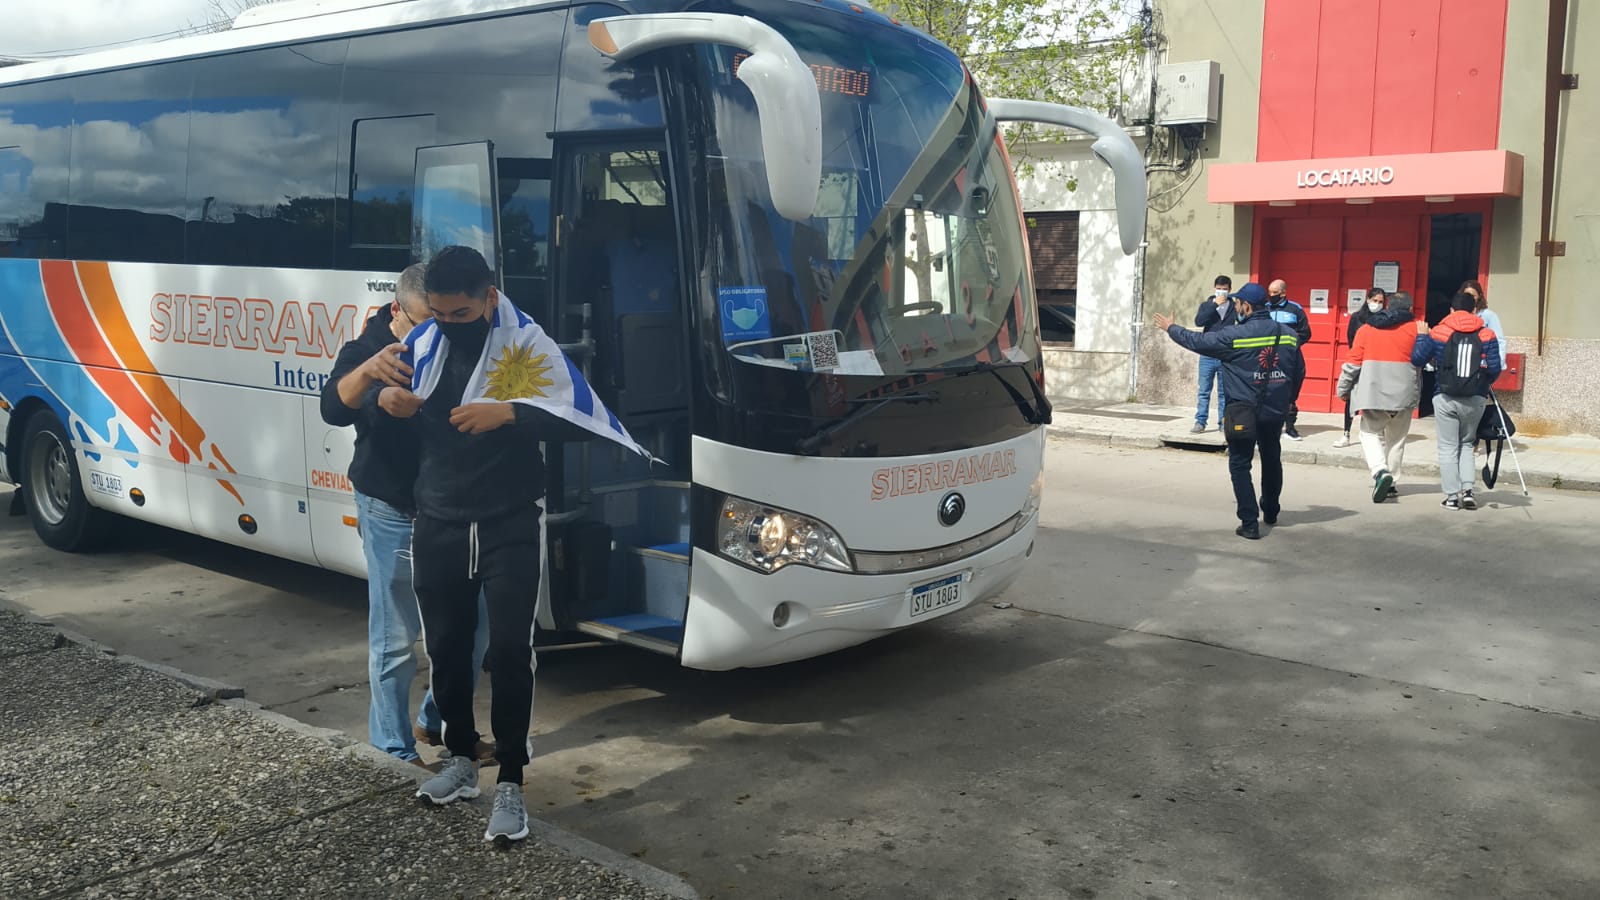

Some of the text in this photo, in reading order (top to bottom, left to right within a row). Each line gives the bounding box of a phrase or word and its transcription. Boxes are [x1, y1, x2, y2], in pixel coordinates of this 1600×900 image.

[1297, 165, 1395, 188] LOCATARIO
[150, 293, 381, 359] SIERRAM
[91, 472, 104, 487] STU
[106, 476, 122, 492] 1803
[871, 448, 1017, 501] SIERRAMAR
[914, 591, 933, 613] STU
[936, 584, 959, 606] 1803
